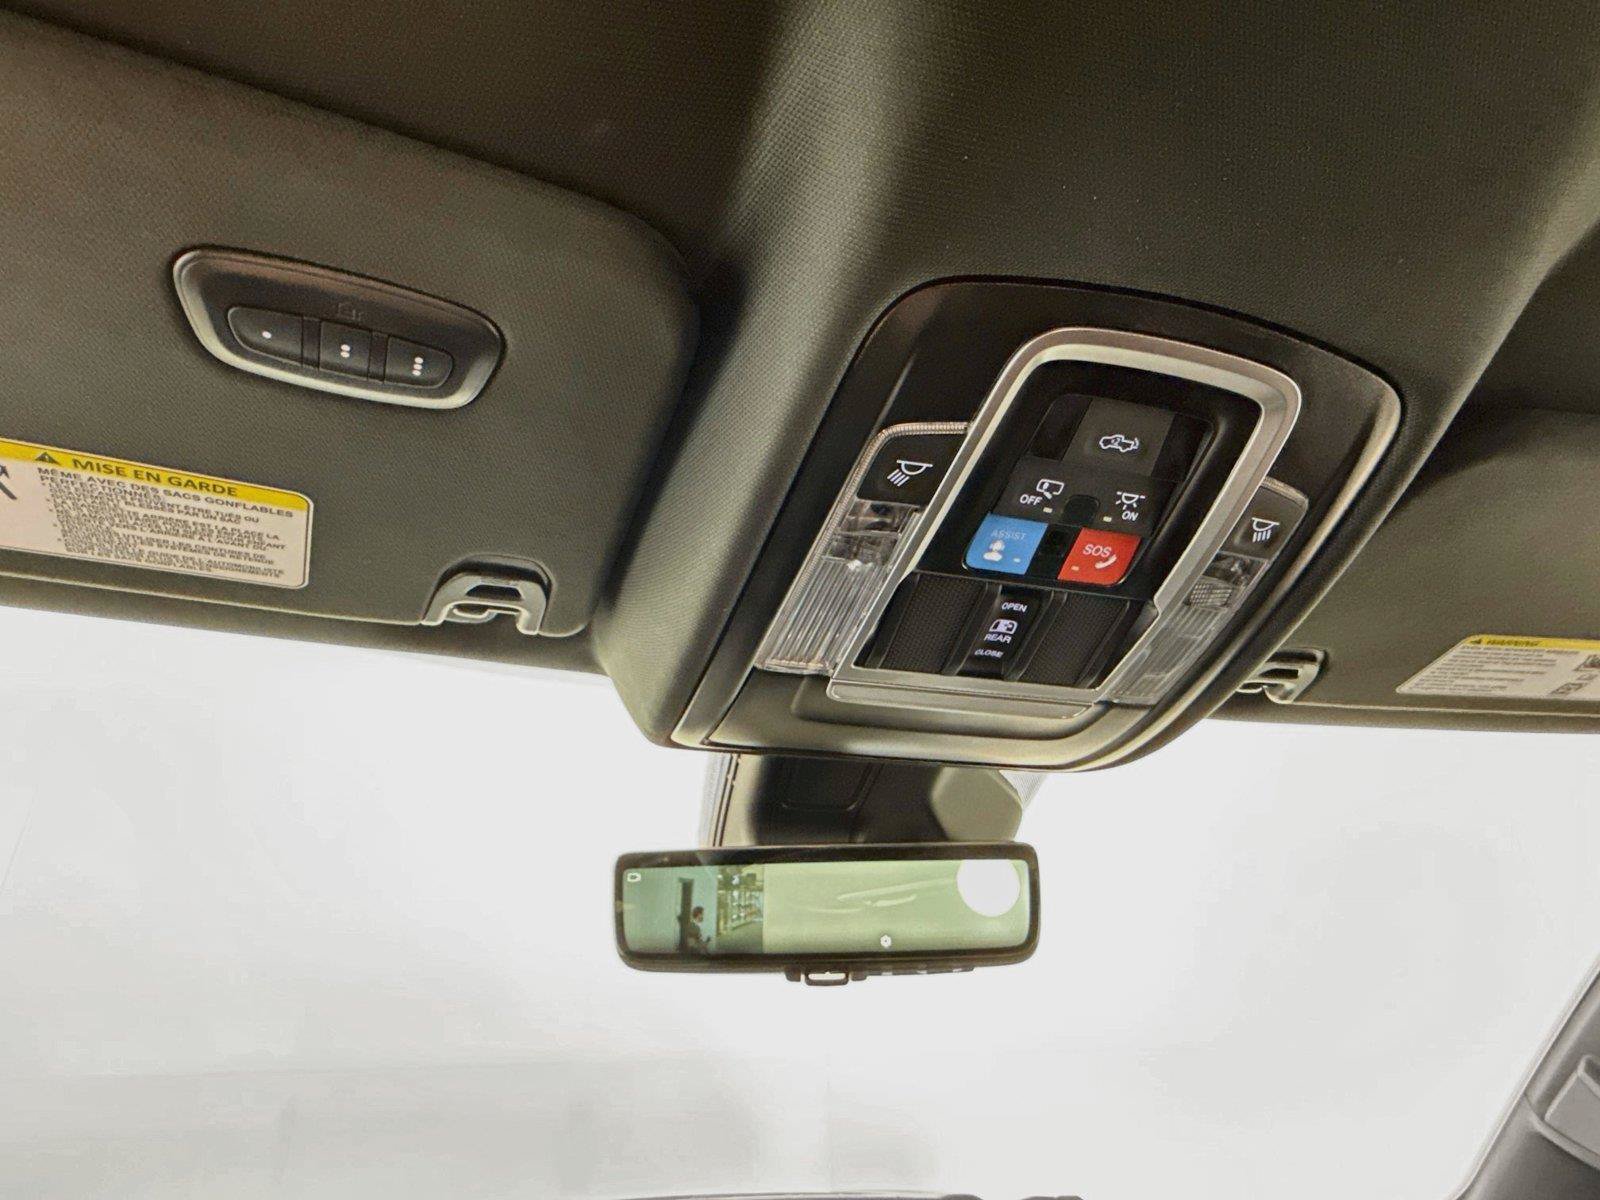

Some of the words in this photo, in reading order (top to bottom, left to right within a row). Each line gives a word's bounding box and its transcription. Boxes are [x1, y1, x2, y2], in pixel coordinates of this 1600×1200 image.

[72, 457, 126, 478] MISE
[133, 469, 162, 483] EN
[168, 475, 238, 497] GARDE
[85, 475, 126, 488] AVEC
[129, 482, 159, 494] DES
[162, 488, 200, 501] SACS
[204, 496, 293, 518] GONFLABLES
[1019, 493, 1043, 506] OFF
[1121, 511, 1139, 522] ON
[990, 529, 1027, 541] ASSIST
[1082, 543, 1112, 557] SOS
[1001, 602, 1028, 613] OPEN
[983, 633, 1012, 644] REAR
[974, 649, 1004, 659] CLOSE
